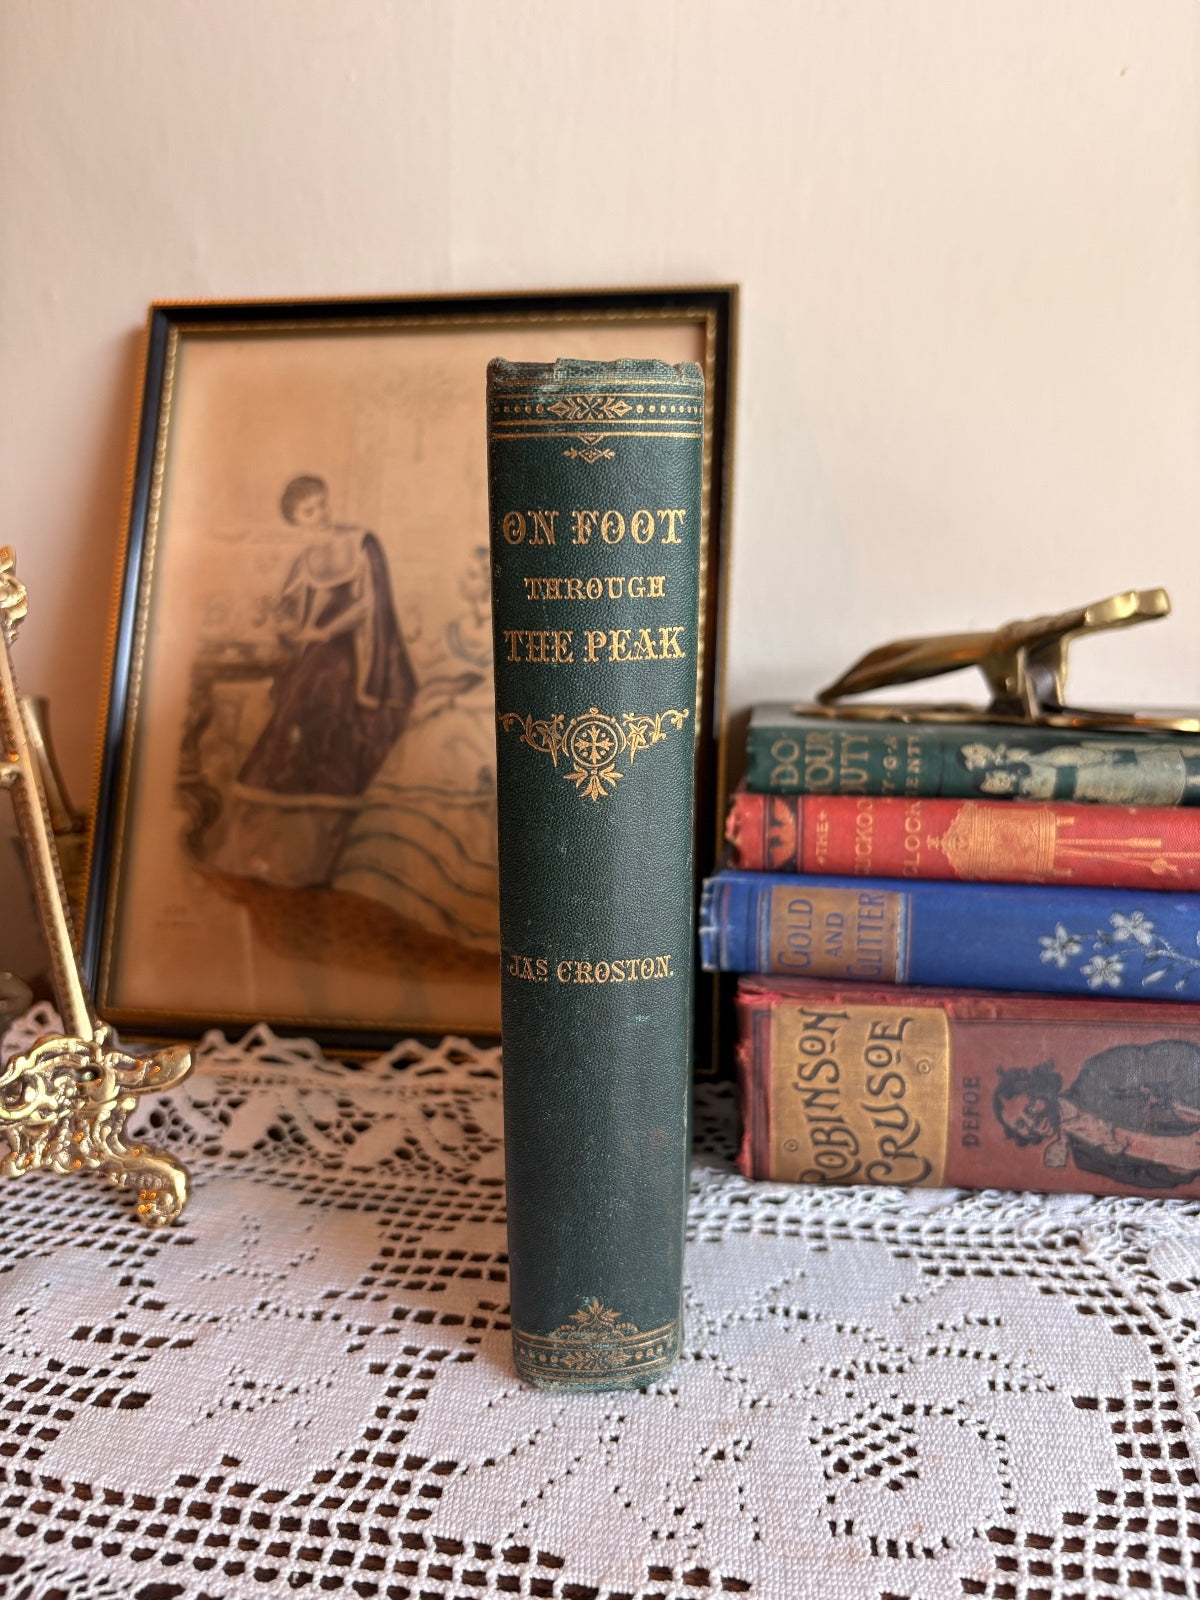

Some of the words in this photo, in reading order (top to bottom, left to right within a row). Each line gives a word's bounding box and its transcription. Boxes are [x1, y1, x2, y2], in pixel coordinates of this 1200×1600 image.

[503, 511, 559, 545] ON
[572, 509, 686, 545] FOOT
[524, 576, 666, 600] THROUGH
[503, 630, 574, 663] THE
[584, 626, 685, 662] PEAK
[770, 739, 799, 787] DO
[816, 821, 829, 857] THE
[777, 899, 813, 969] GOLD
[824, 912, 844, 958] AND
[846, 893, 885, 978] GLITTER
[557, 955, 674, 984] CROSTON.
[792, 1007, 862, 1183] ROBINSON
[861, 1016, 933, 1184] CRUSOE
[962, 1075, 981, 1147] DEFOE
